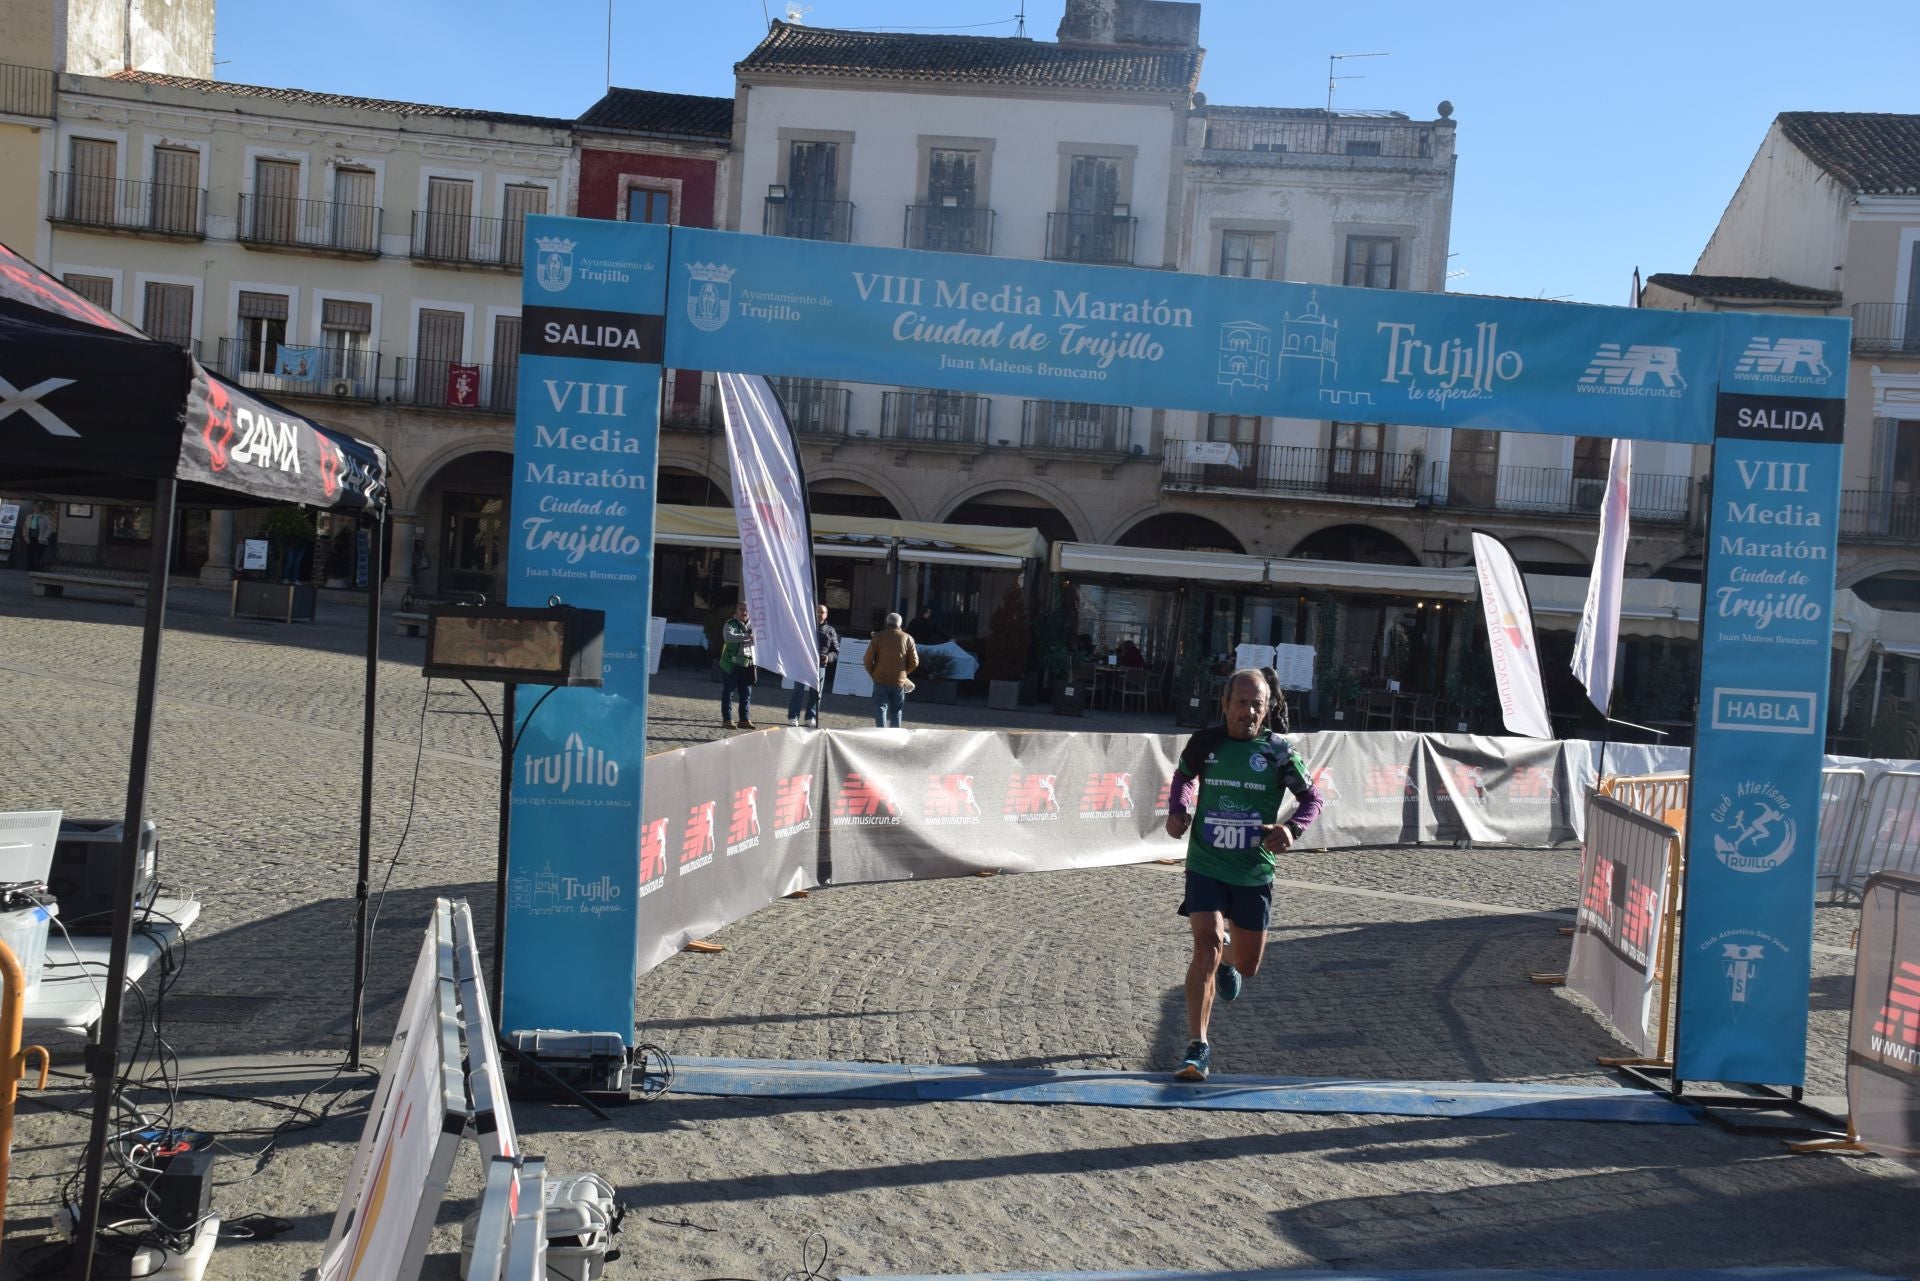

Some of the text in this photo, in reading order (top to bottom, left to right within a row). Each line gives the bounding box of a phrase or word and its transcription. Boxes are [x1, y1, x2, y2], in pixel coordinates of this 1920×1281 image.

[579, 268, 629, 284] Trujillo
[580, 257, 655, 272] Ayuntamiento de
[740, 289, 833, 307] Ayuntamiento de
[851, 271, 1194, 328] VIII Media Maratón
[738, 302, 800, 322] Trujillo
[544, 322, 640, 350] SALIDA
[892, 310, 1165, 369] Ciudad de Trujillo
[940, 354, 1107, 381] Juan Mateos Broncano
[1376, 321, 1523, 393] Trujillo
[1408, 379, 1424, 400] te
[1734, 372, 1827, 385] www.musicrun.es
[543, 380, 628, 417] VIII
[1577, 383, 1682, 398] www.musicrun.es
[1738, 408, 1824, 431] SALIDA
[533, 425, 640, 454] Media
[525, 462, 646, 490] Maratón
[1735, 460, 1810, 492] VIII
[539, 496, 628, 517] Ciudad de
[1726, 502, 1822, 527] Media
[522, 517, 641, 564] Trujillo
[1719, 536, 1827, 560] Maratón
[526, 567, 636, 581] Juan Mateos Broncano
[1730, 566, 1809, 585] Ciudad de
[1716, 586, 1822, 630] Trujillo
[1718, 632, 1818, 646] Juan Mateos Broncano
[1727, 702, 1800, 721] HABLA
[1710, 780, 1790, 822] Club Atletismo
[833, 815, 901, 826] www.musicrun.es
[1004, 812, 1058, 823] www.musicrun.es
[1213, 826, 1245, 849] 201
[680, 854, 713, 877] www.musicrun.es
[1720, 851, 1776, 869] TRUJILLO
[562, 876, 620, 901] Trujillo
